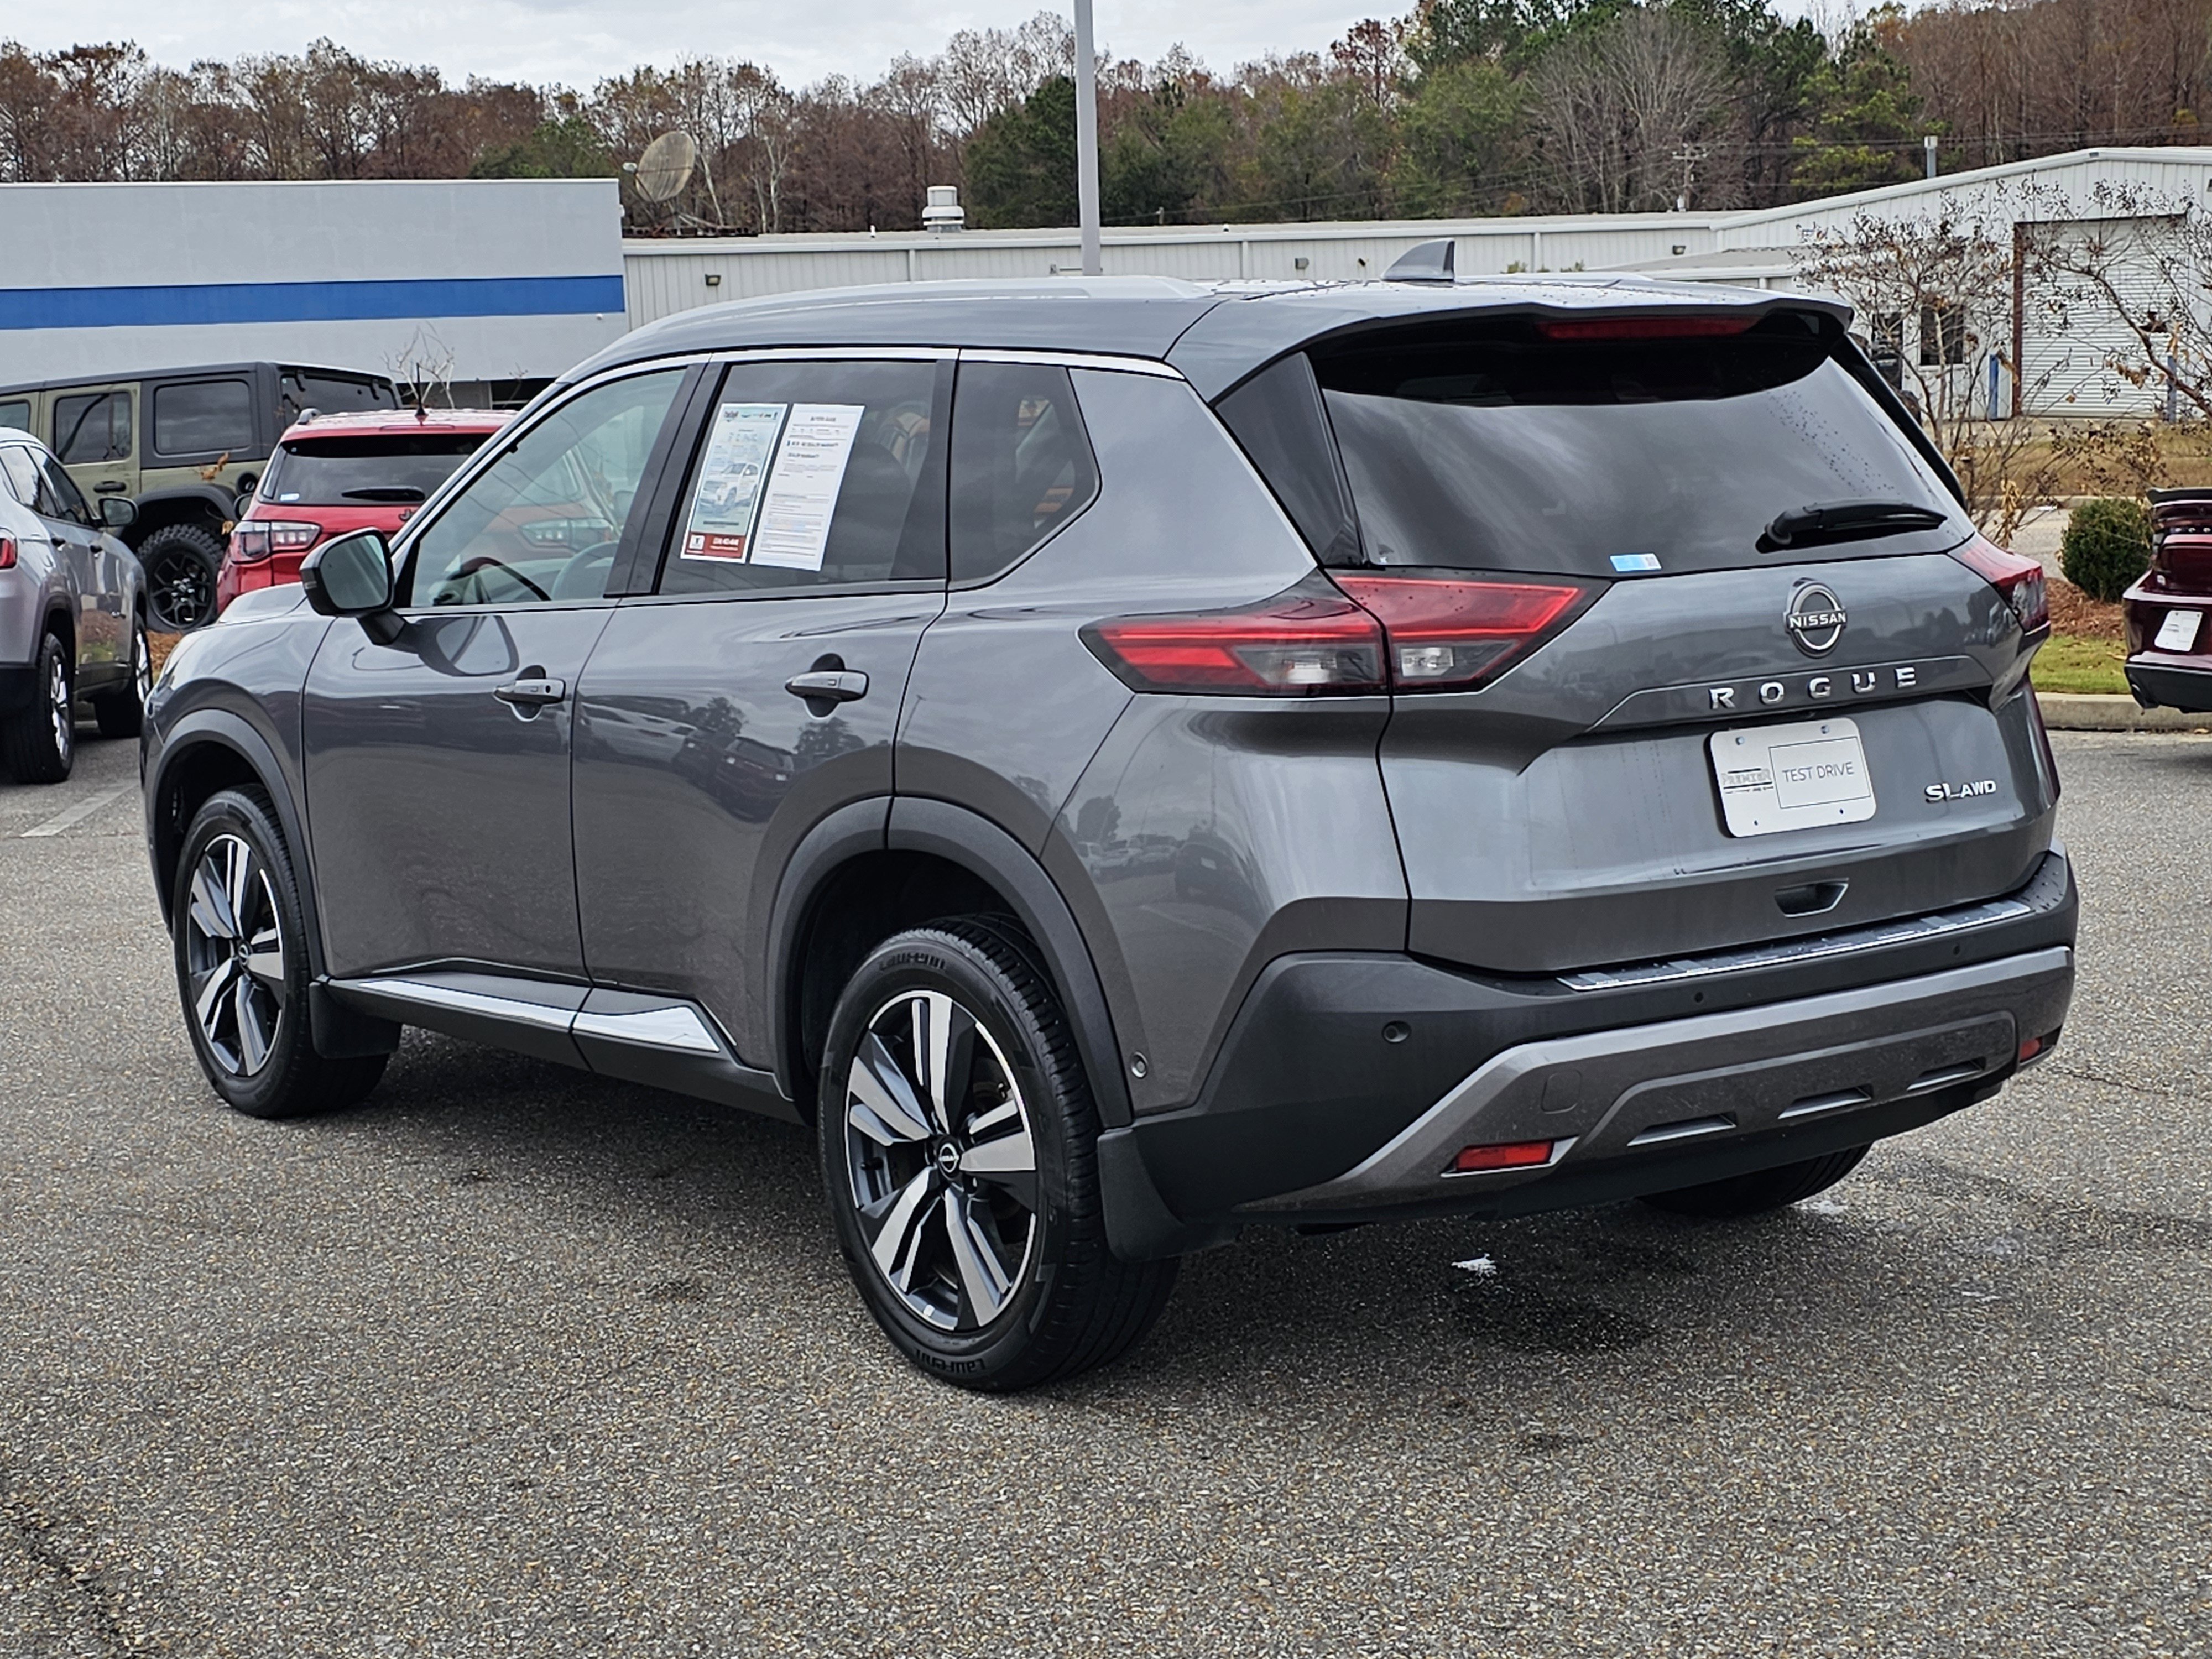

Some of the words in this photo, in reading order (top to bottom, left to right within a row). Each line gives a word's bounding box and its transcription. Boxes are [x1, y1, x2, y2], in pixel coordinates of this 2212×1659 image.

[1789, 612, 1846, 628] NISSAN
[1708, 666, 1917, 710] ROGUE
[1782, 766, 1813, 782] TEST
[1816, 761, 1854, 779] DRIVE
